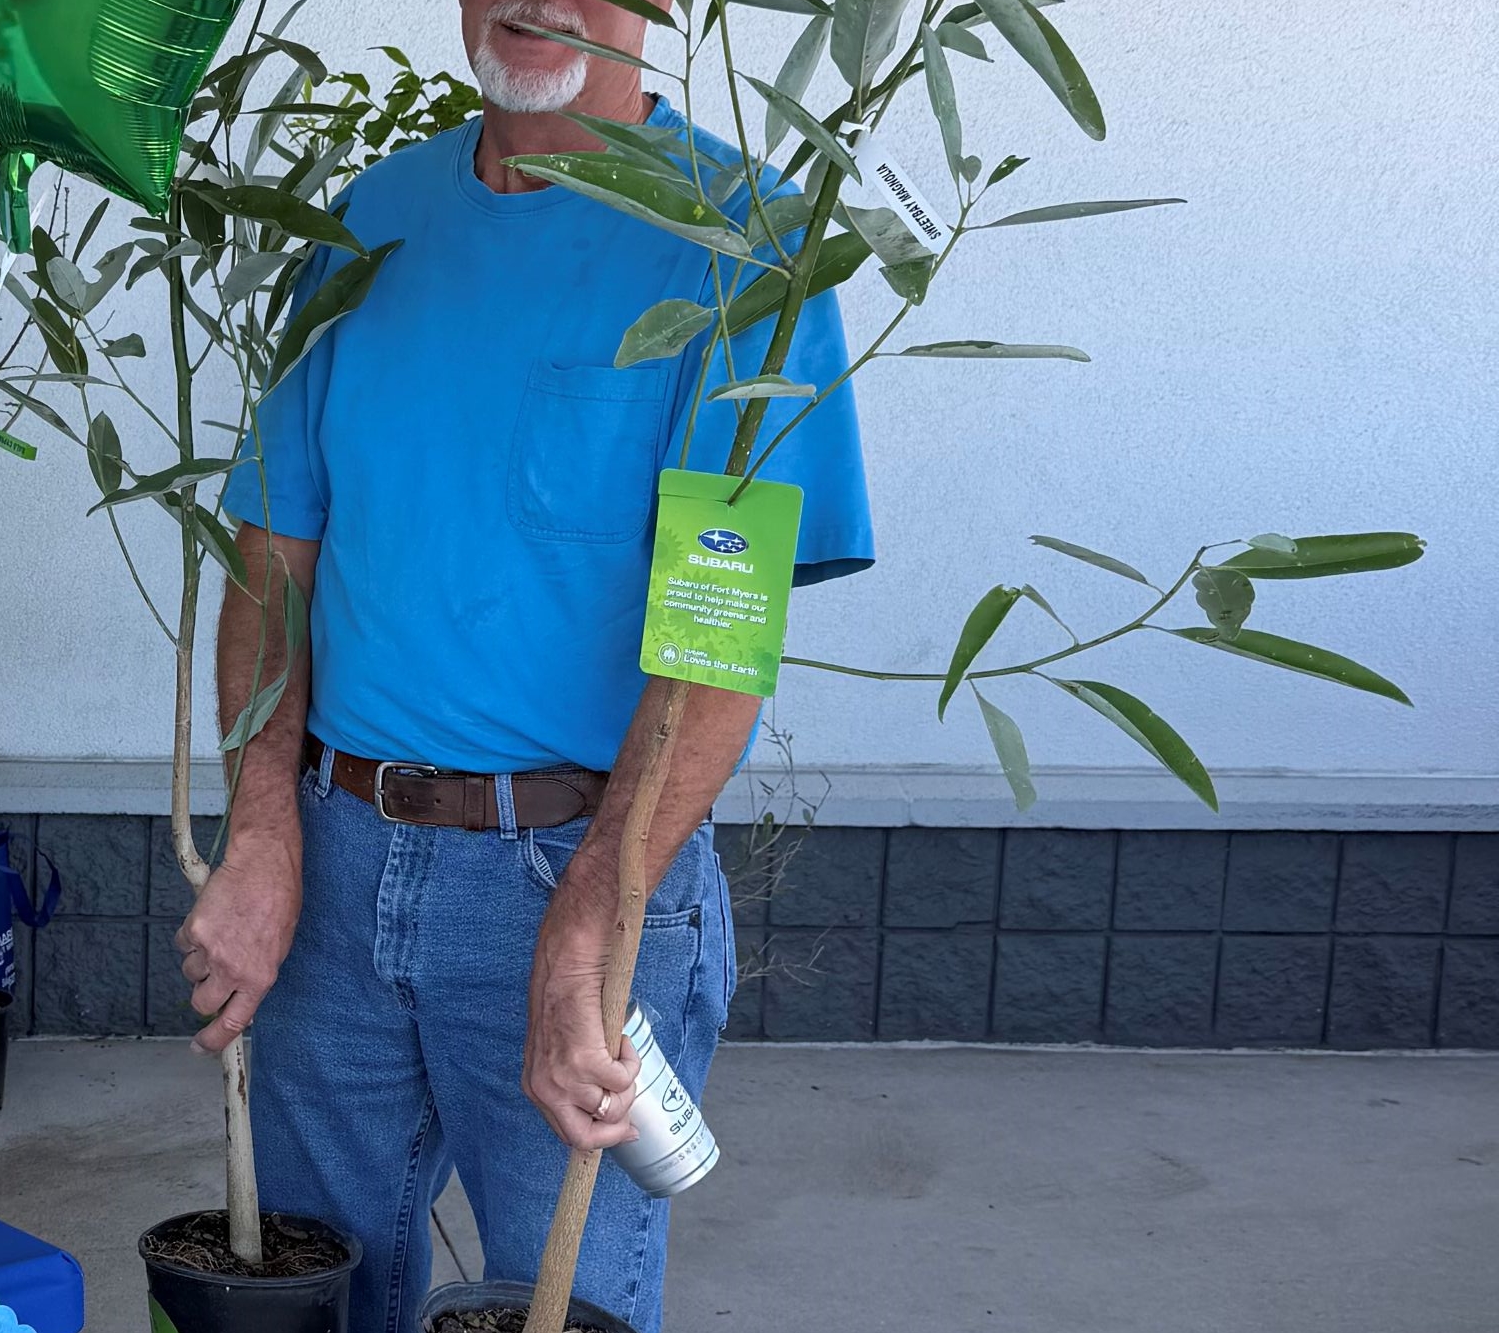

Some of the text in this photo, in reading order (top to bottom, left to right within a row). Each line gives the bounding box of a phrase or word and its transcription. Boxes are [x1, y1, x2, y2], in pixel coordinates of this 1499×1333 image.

[875, 163, 942, 240] SWEETBAY MAGNOLIA
[688, 553, 754, 575] SUBARU
[666, 588, 767, 613] proud to help make our
[668, 577, 768, 602] Subaru of Fort Myers is
[663, 599, 767, 624] community greener and
[683, 654, 758, 676] Loves the Earth
